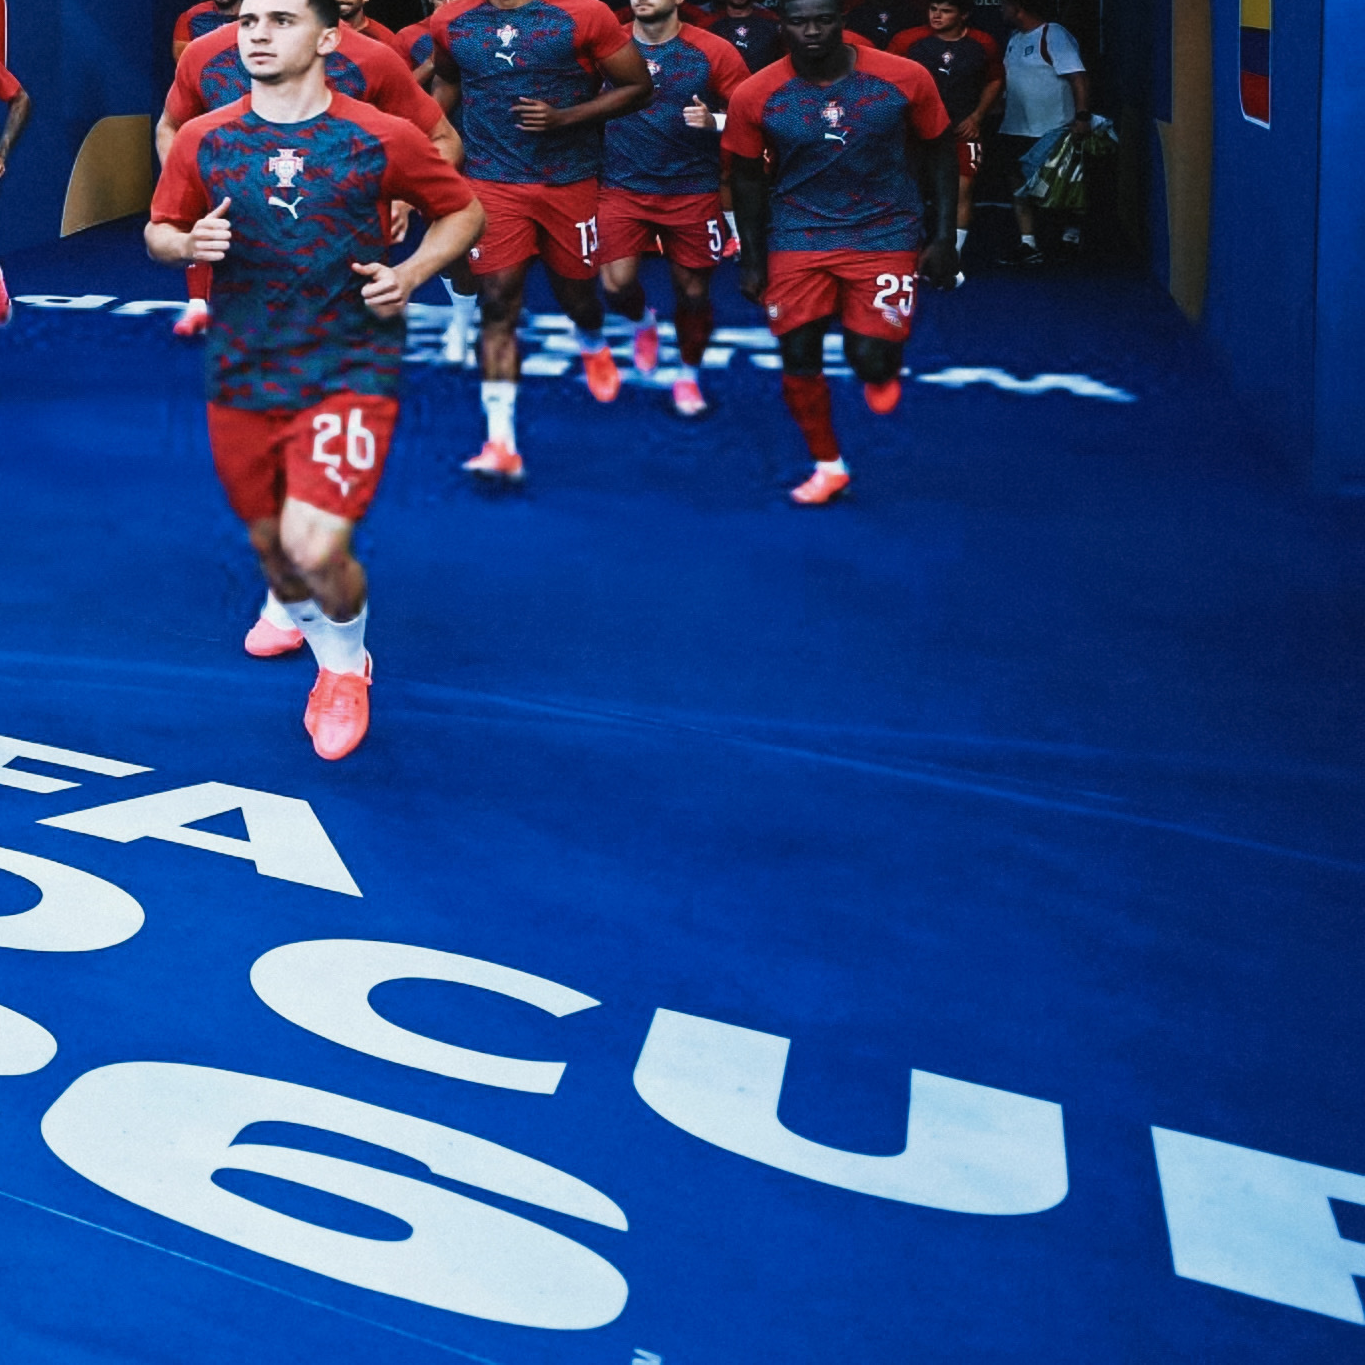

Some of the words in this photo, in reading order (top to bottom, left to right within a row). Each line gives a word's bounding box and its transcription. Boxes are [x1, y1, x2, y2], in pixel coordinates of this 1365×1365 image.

[706, 219, 722, 252] 5
[873, 273, 914, 317] 25
[312, 408, 376, 469] 26
